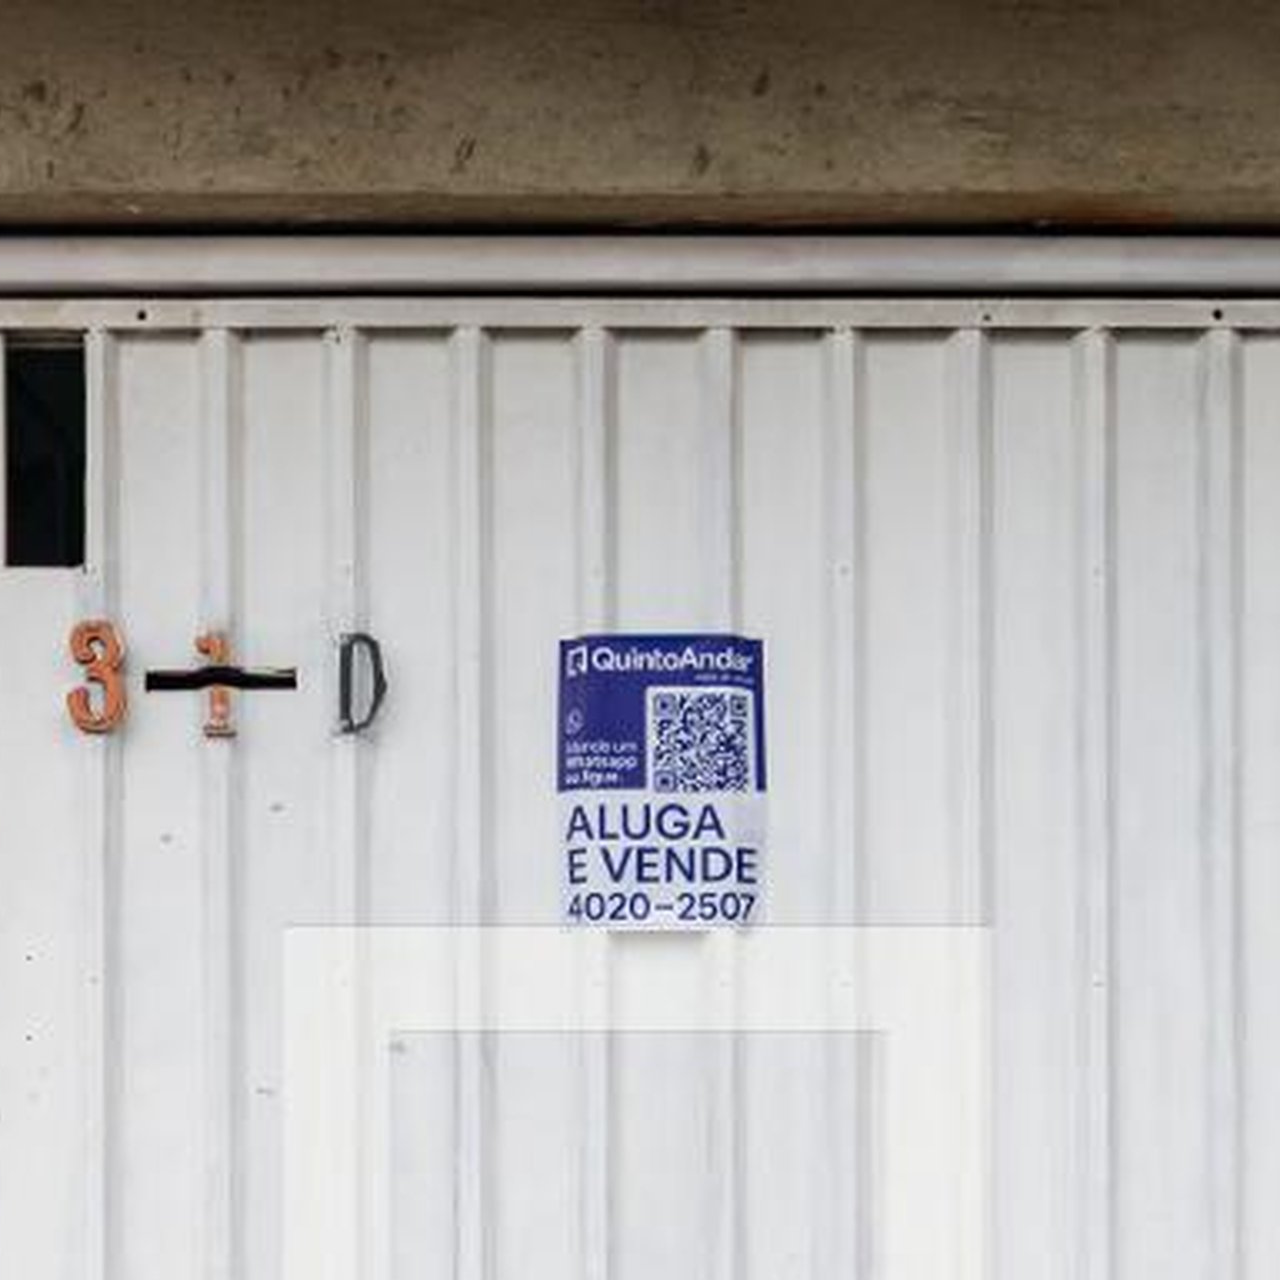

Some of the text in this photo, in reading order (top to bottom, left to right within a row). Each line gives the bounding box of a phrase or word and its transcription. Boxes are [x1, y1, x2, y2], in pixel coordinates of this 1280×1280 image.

[66, 619, 128, 734] 3
[565, 803, 725, 841] ALUGA
[568, 847, 757, 884] E VENDE
[569, 892, 755, 921] 4020-2507
